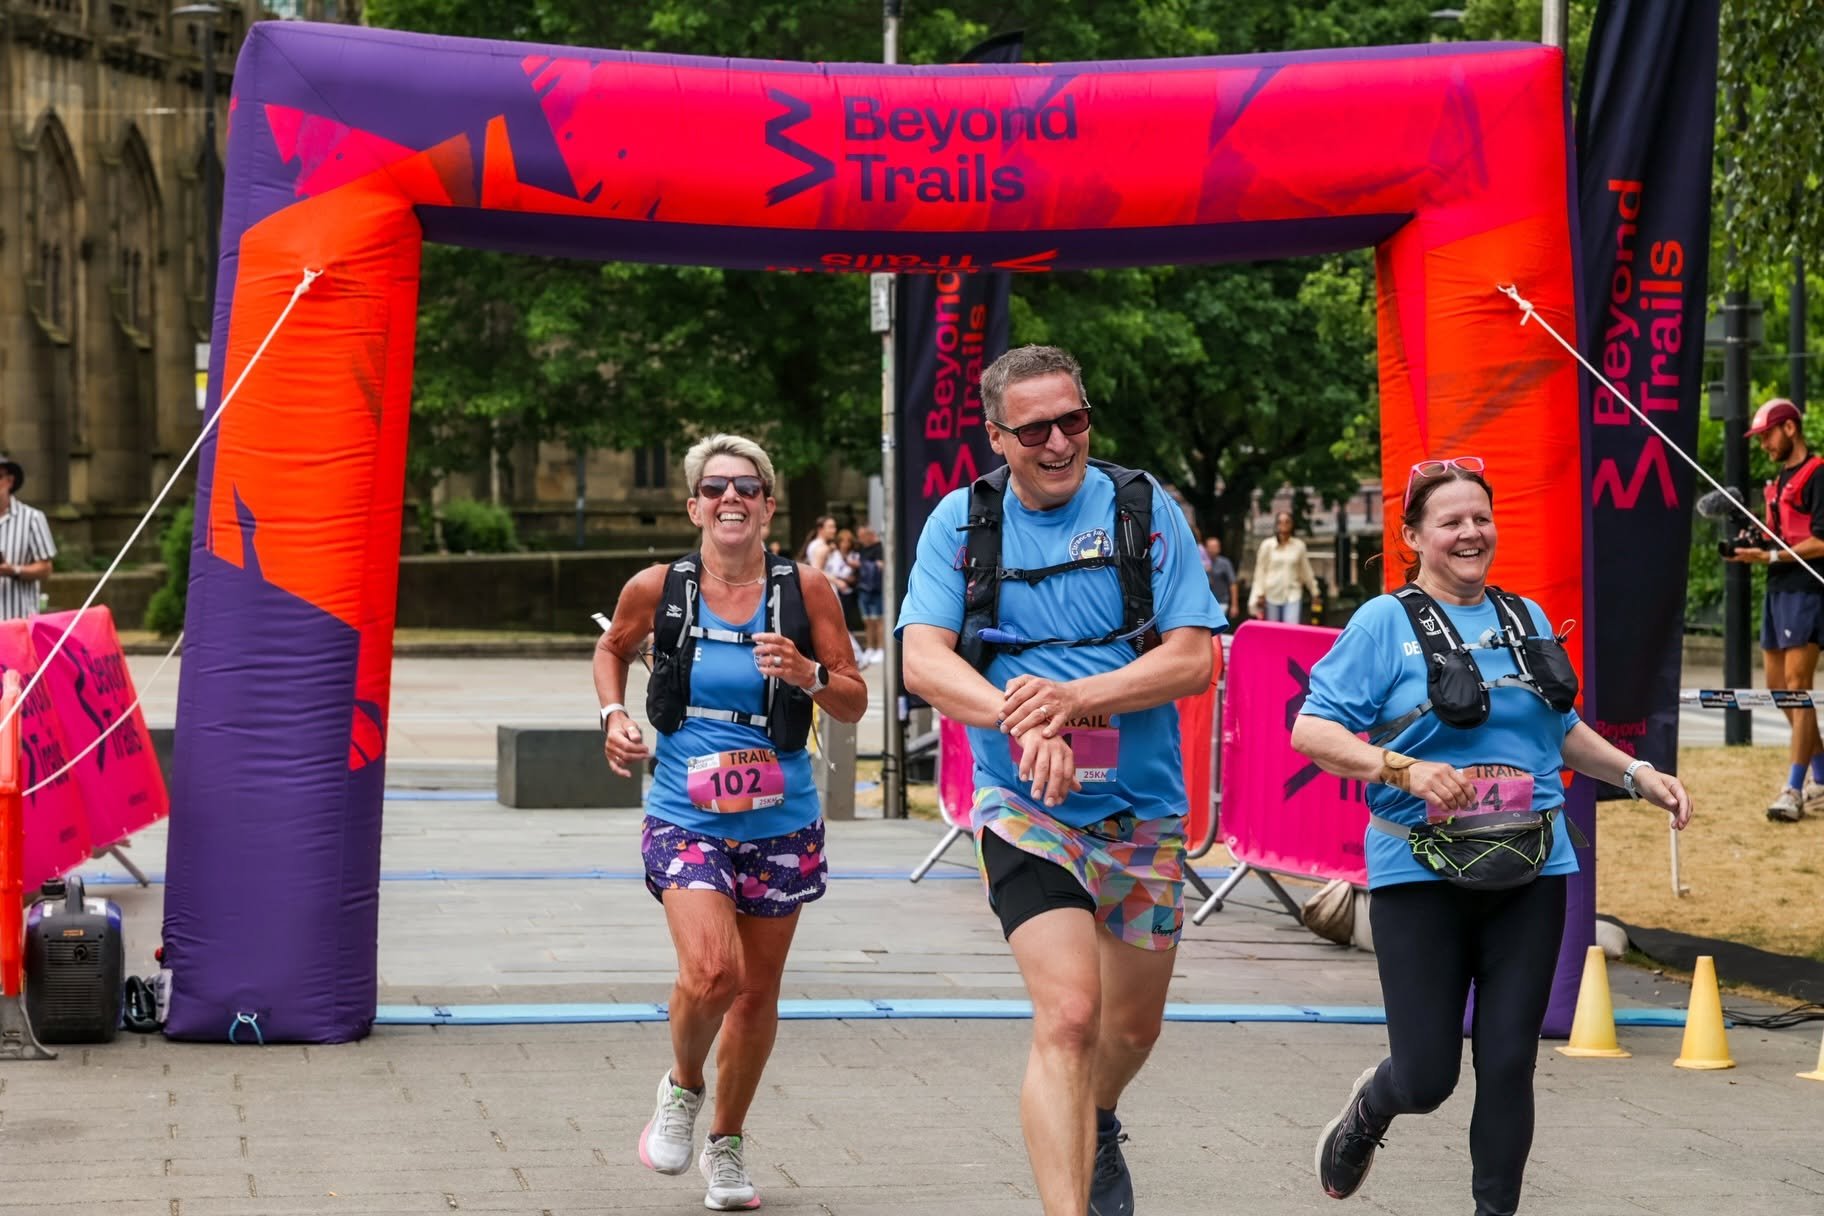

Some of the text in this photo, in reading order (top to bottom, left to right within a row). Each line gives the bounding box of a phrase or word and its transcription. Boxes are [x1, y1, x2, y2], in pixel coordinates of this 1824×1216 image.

[844, 94, 1078, 154] Beyond
[845, 153, 1025, 204] Trails
[1593, 179, 1643, 426] Beyond
[1640, 240, 1684, 426] Trails
[955, 303, 987, 438] Trails
[1403, 640, 1423, 657] DE
[1064, 714, 1107, 728] RAIL
[710, 768, 762, 797] 102
[728, 750, 770, 765] TRAIL
